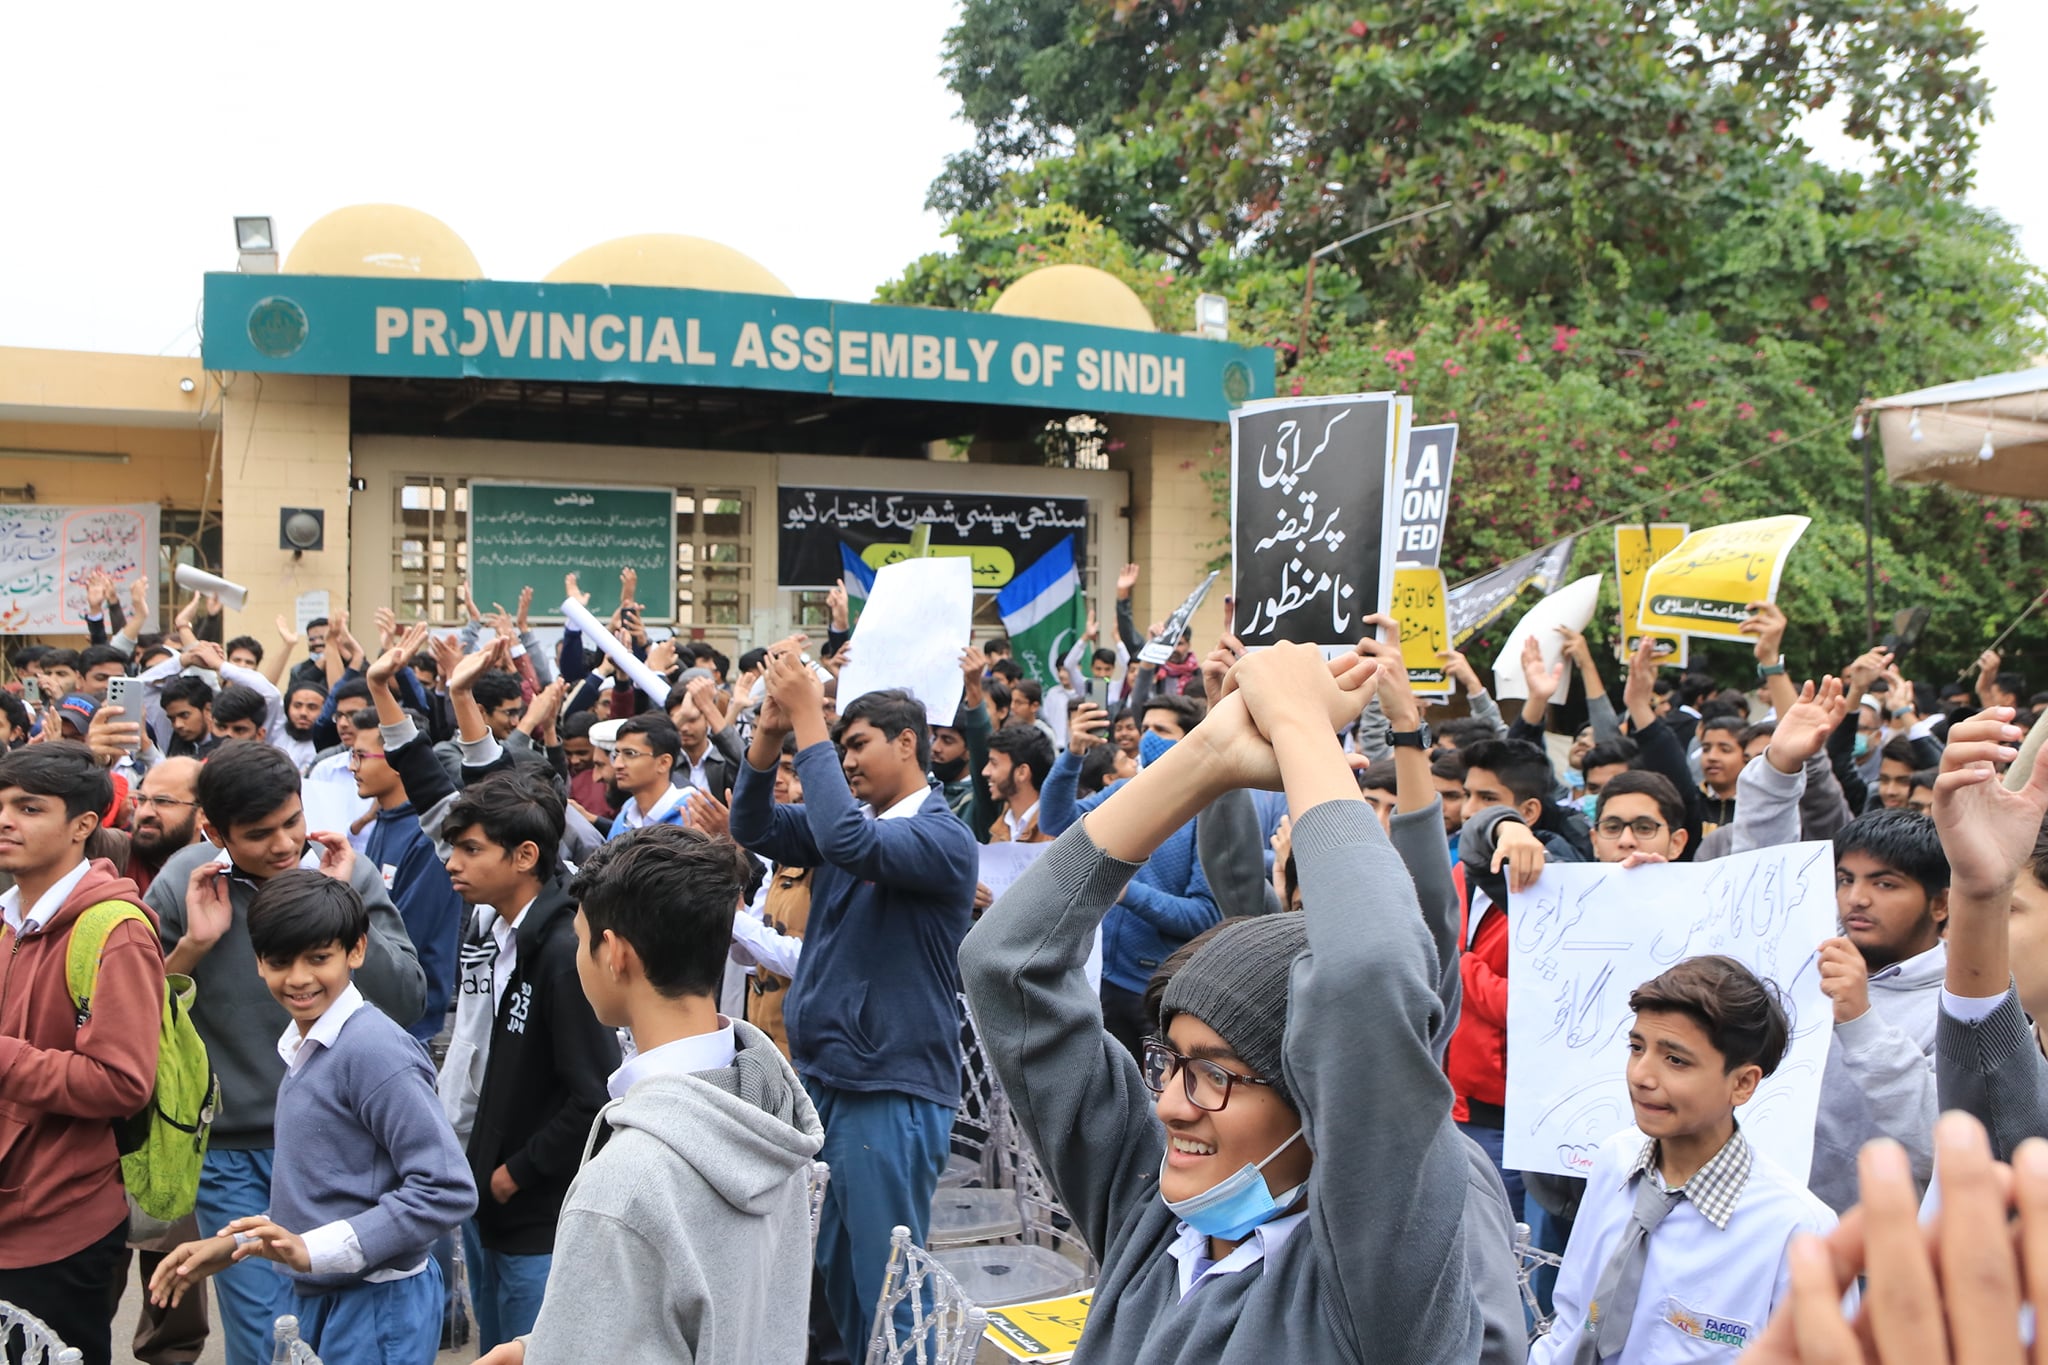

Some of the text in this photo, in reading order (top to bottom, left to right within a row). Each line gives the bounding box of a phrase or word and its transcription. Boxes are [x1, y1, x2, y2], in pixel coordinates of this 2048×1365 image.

[376, 306, 1185, 398] PROVINCIAL ASSEMBLY OF SINDH
[1258, 408, 1351, 495] کراچی
[1404, 443, 1440, 488] A
[1254, 490, 1346, 553] پر قبضہ
[509, 991, 530, 1021] 23
[1703, 1329, 1744, 1349] SCHOOL
[1705, 1318, 1747, 1338] FAROOQ
